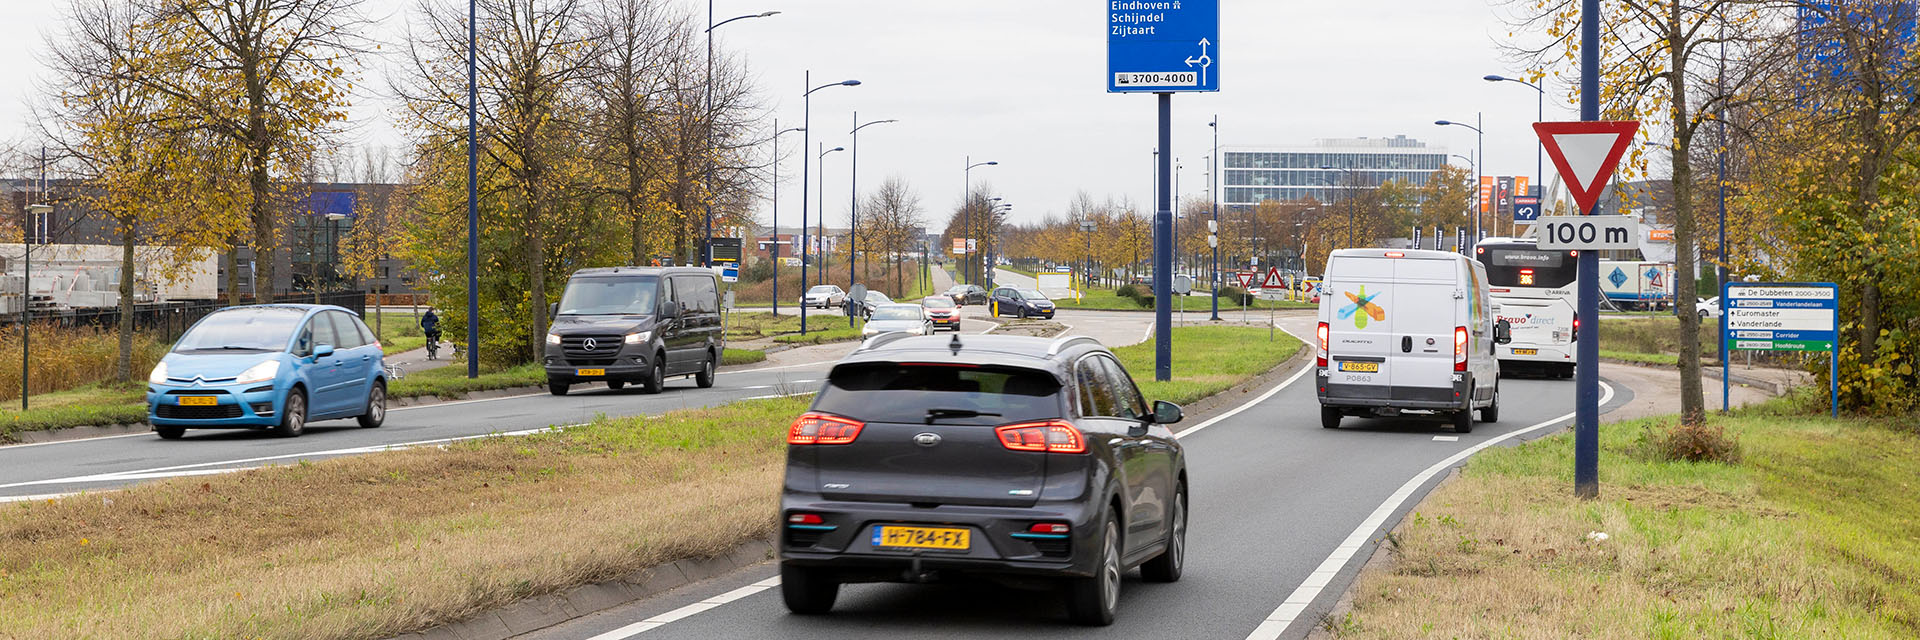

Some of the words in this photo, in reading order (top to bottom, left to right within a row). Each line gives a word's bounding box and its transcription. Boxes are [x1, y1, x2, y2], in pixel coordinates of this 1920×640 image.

[1111, 0, 1170, 10] Eindhoven
[1111, 12, 1164, 25] Schijndel
[1111, 25, 1155, 37] Zijtaart
[1132, 73, 1194, 83] 3700-4000
[1546, 222, 1597, 244] 100
[1605, 226, 1628, 244] m
[1530, 316, 1555, 325] direct
[886, 532, 963, 546] H-784-FX
